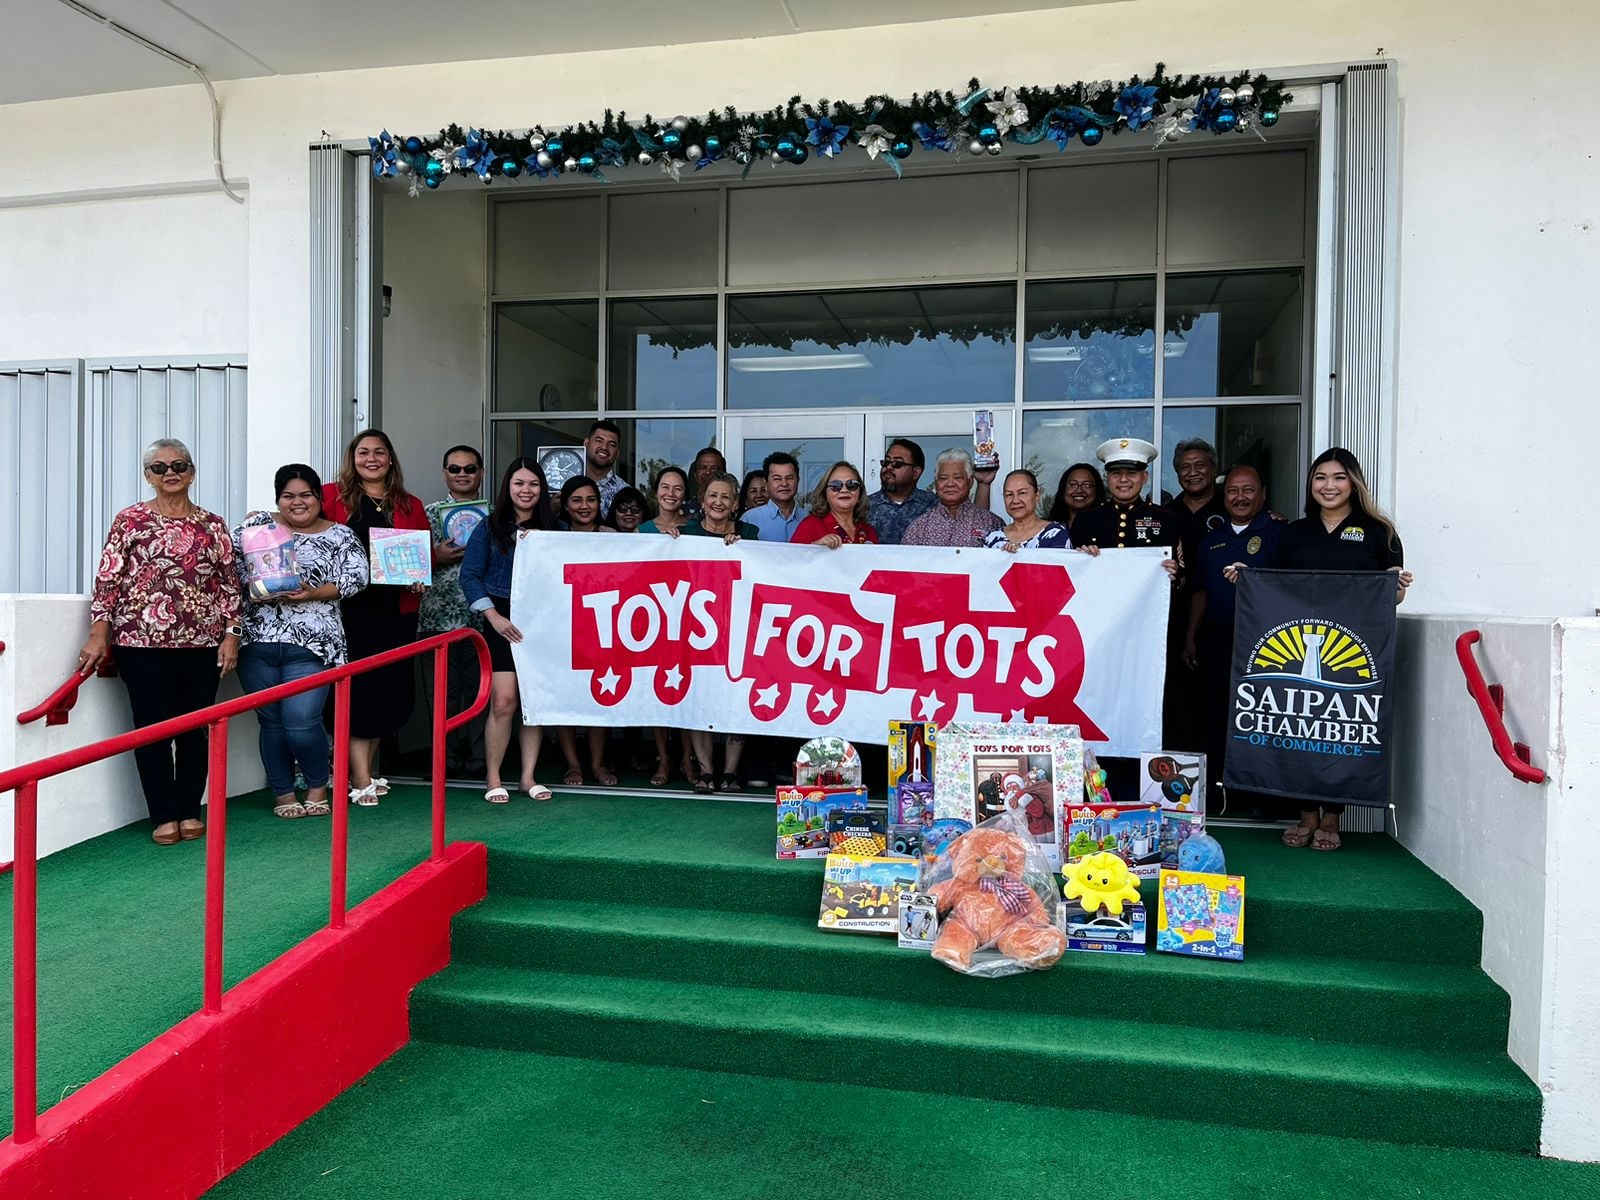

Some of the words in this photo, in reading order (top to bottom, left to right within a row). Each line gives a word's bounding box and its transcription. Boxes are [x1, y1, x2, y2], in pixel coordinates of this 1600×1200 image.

[582, 580, 718, 652] TOYS
[753, 603, 863, 677] FOR
[903, 620, 1058, 697] TOTS
[1246, 650, 1257, 673] MOVING
[1254, 637, 1266, 650] OUR
[1264, 619, 1299, 638] COMMUNITY
[1300, 618, 1334, 627] FORWARD
[1335, 623, 1362, 644] THROUGH
[1360, 643, 1378, 680] ENTERPRISE
[1235, 682, 1383, 722] SAIPAN
[1235, 712, 1381, 745] CHAMBER
[1249, 733, 1270, 746] OF
[1272, 737, 1362, 757] COMMERCE
[1001, 745, 1024, 753] FOR
